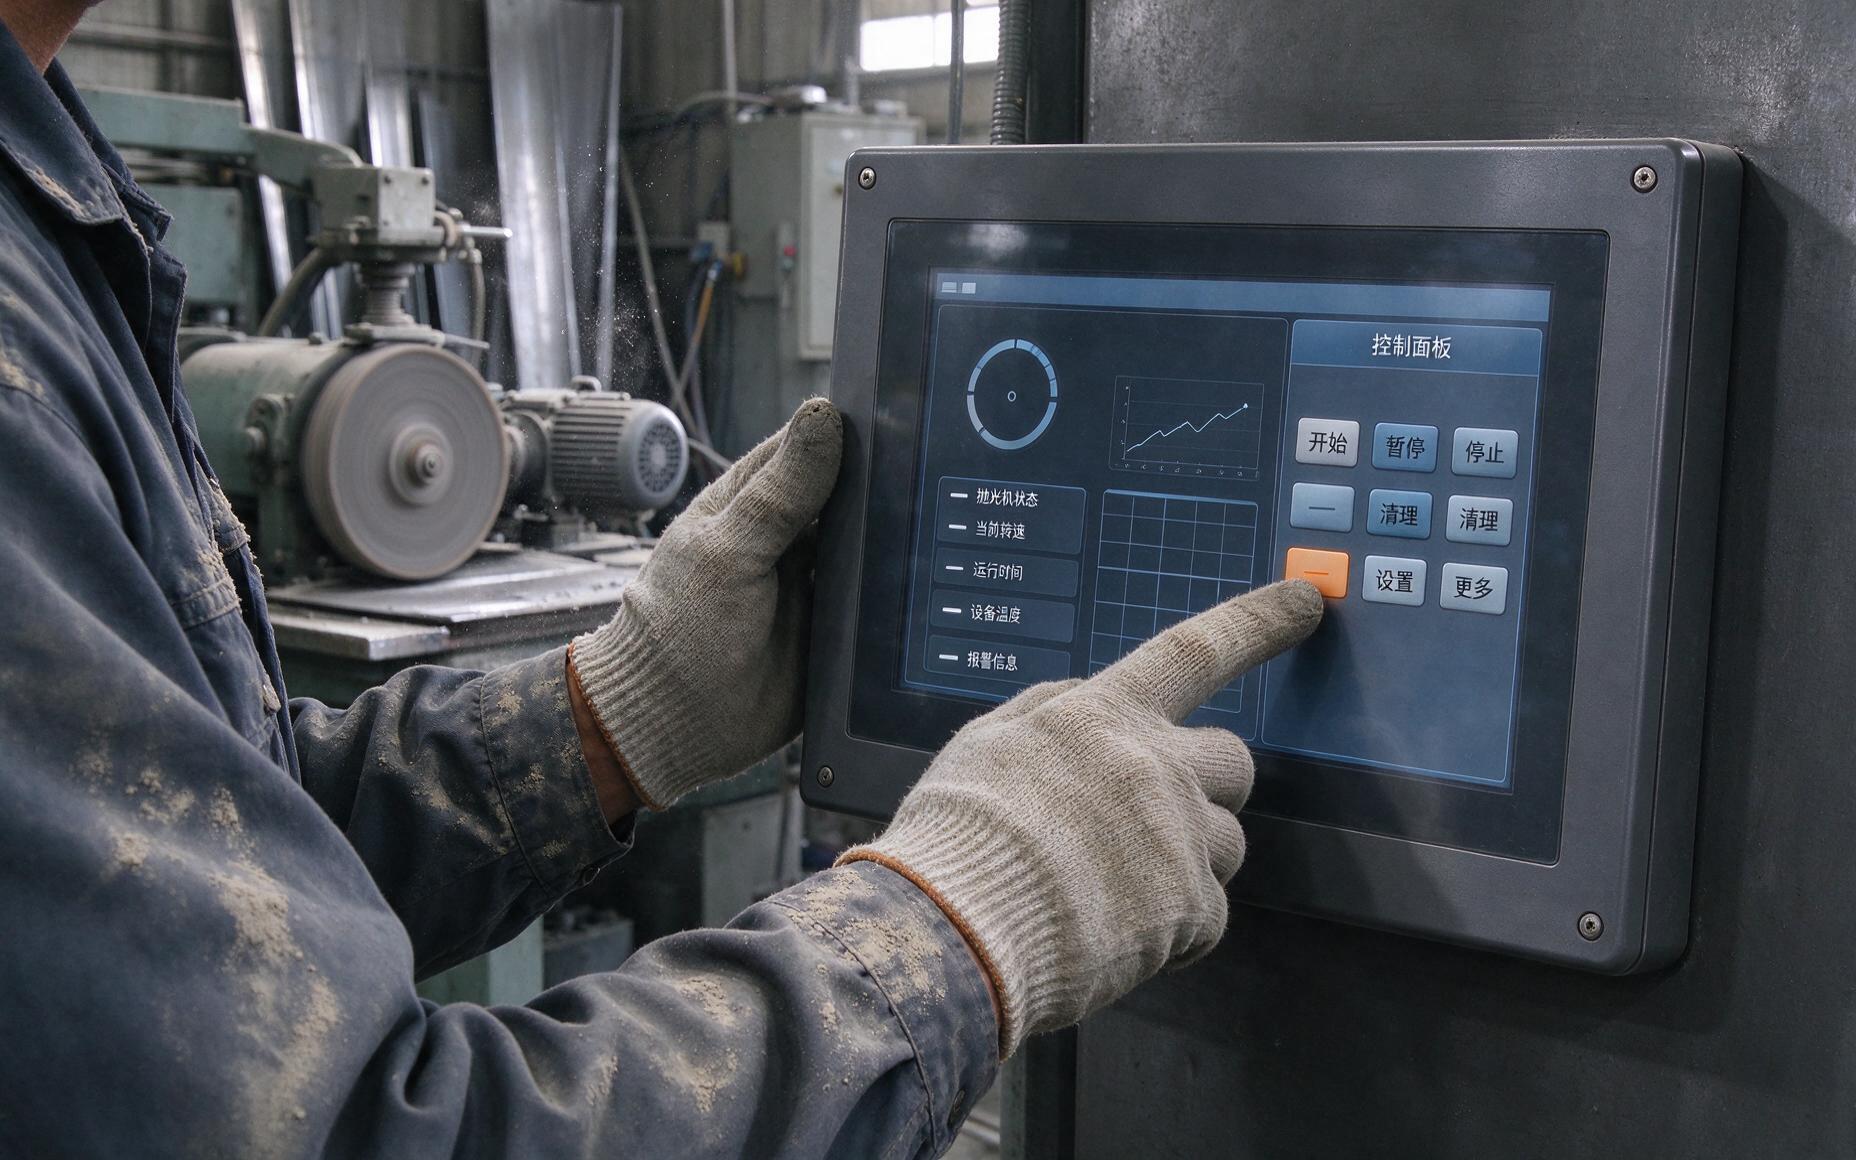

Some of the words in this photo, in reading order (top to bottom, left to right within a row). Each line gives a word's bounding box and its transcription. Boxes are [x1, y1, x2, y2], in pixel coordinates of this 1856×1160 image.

[1372, 333, 1453, 359] 控制面板
[1309, 431, 1348, 455] 开始
[1386, 435, 1425, 460] 暂停
[1466, 440, 1505, 464] 停止
[976, 487, 1039, 507] 抛光机状态
[1380, 503, 1418, 526] 清理
[1460, 507, 1498, 532] 清理
[973, 561, 1023, 581] 运行时间
[1376, 569, 1413, 593] 设置
[1454, 575, 1493, 600] 更多
[967, 651, 1018, 672] 报警信息
